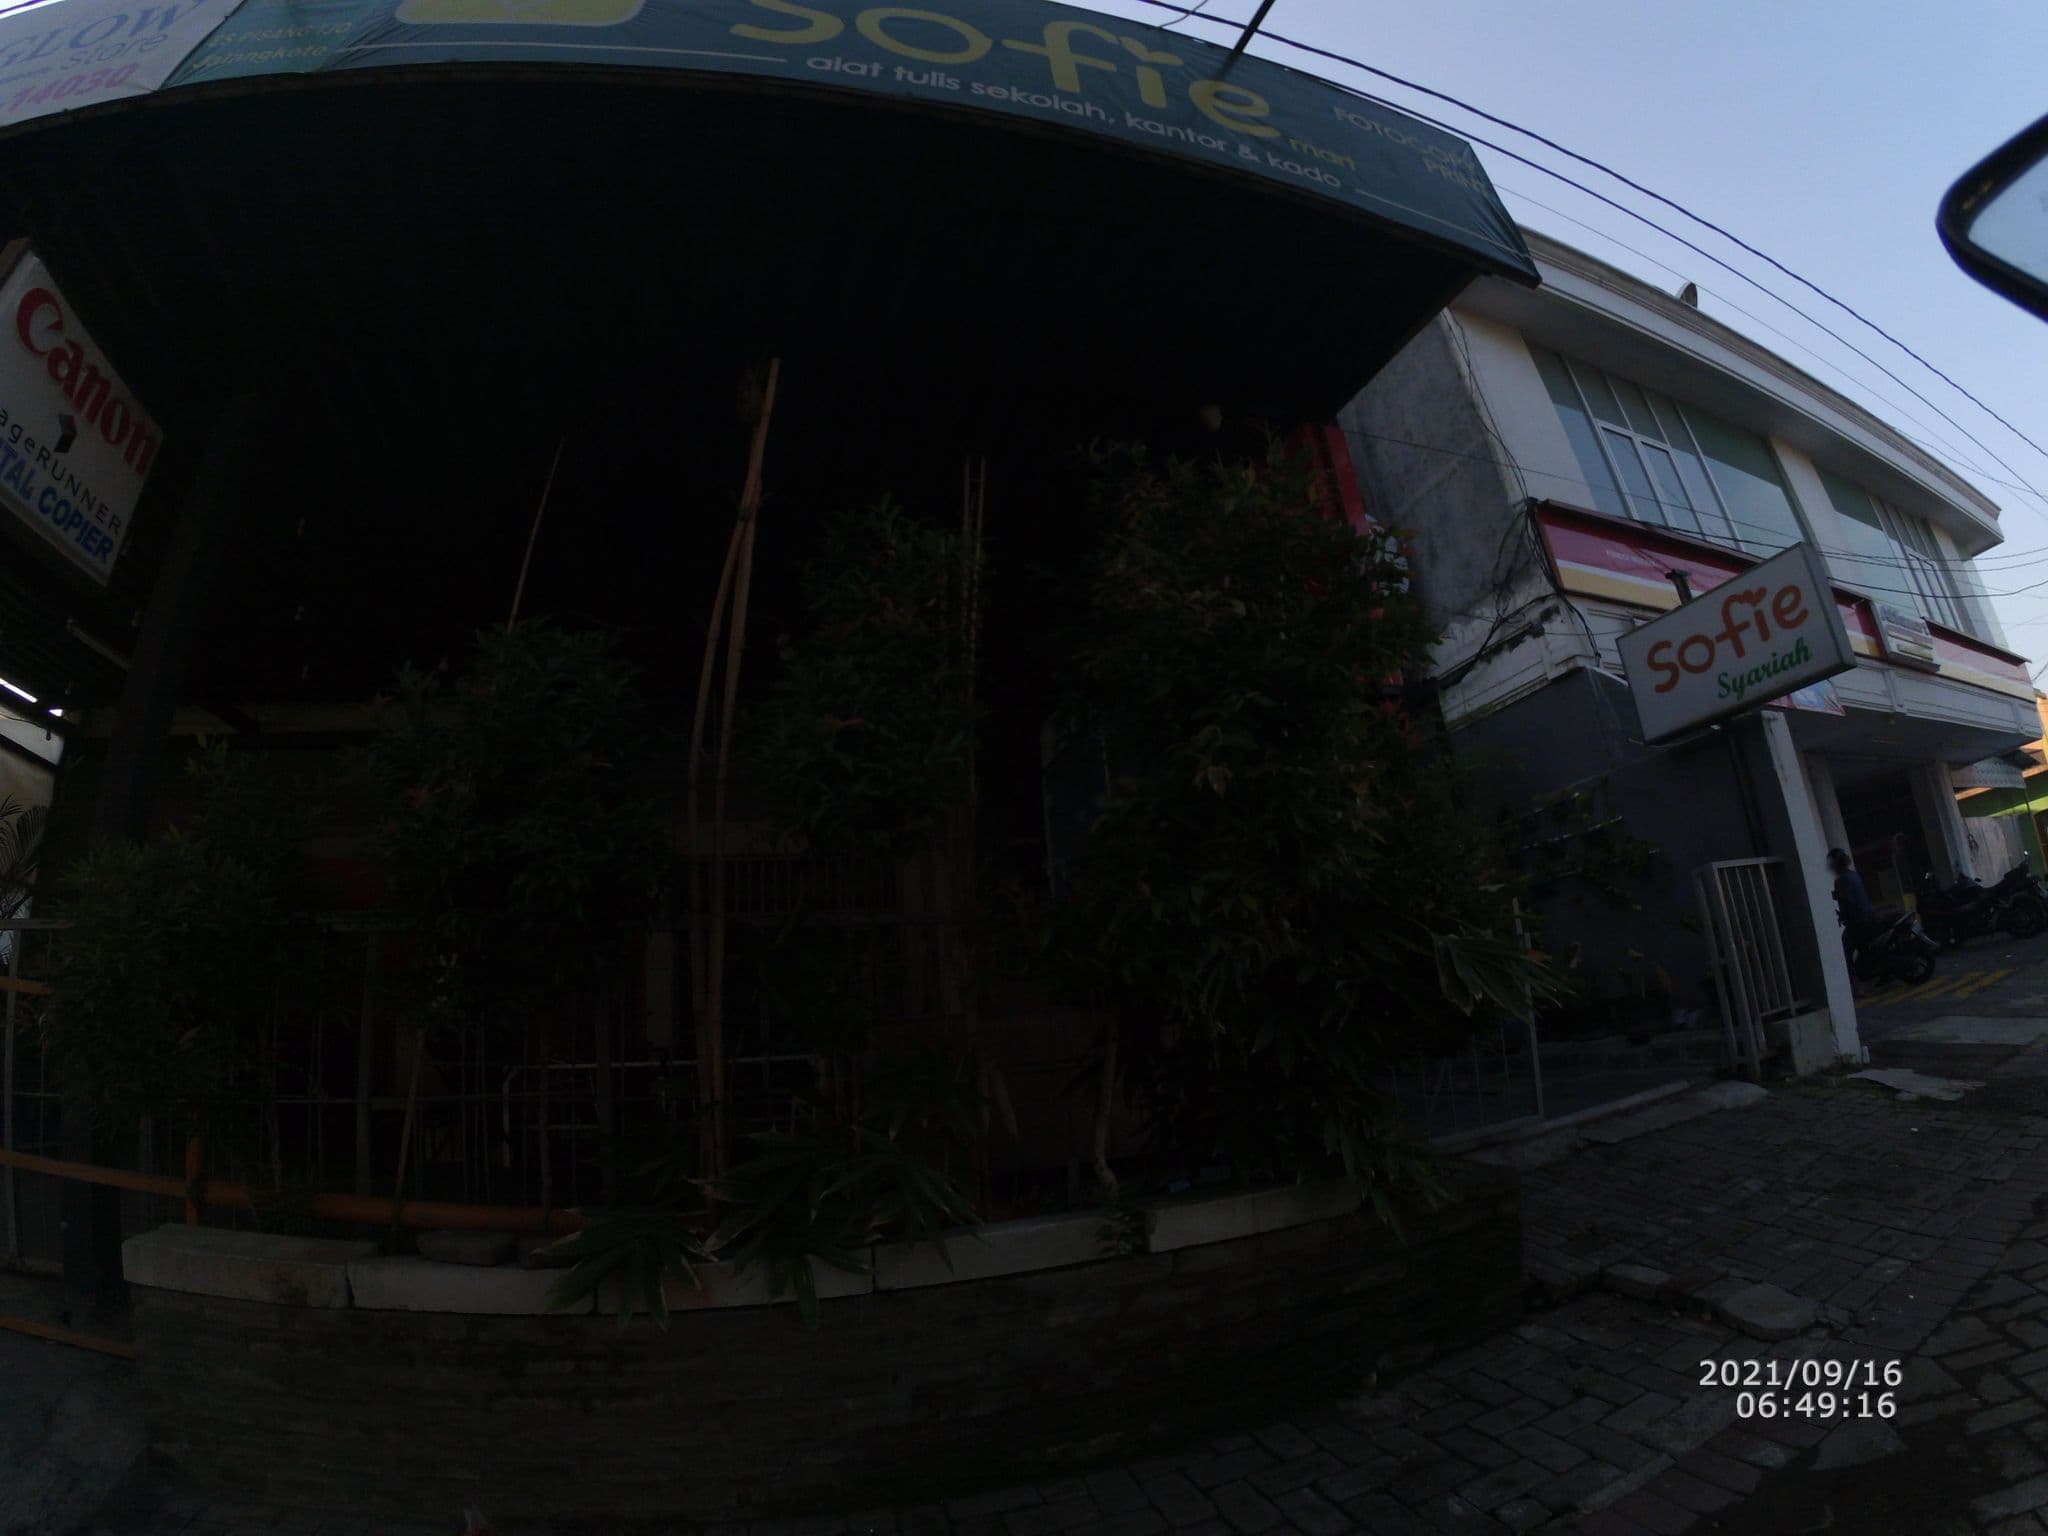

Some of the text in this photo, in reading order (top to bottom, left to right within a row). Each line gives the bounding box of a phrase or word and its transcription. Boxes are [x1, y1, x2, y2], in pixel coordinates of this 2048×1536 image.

[806, 56, 1341, 188] alat tulis sekolah, kantor & kado
[17, 288, 157, 476] Canon
[38, 486, 114, 564] COPIER
[1717, 636, 1813, 700] Syariah
